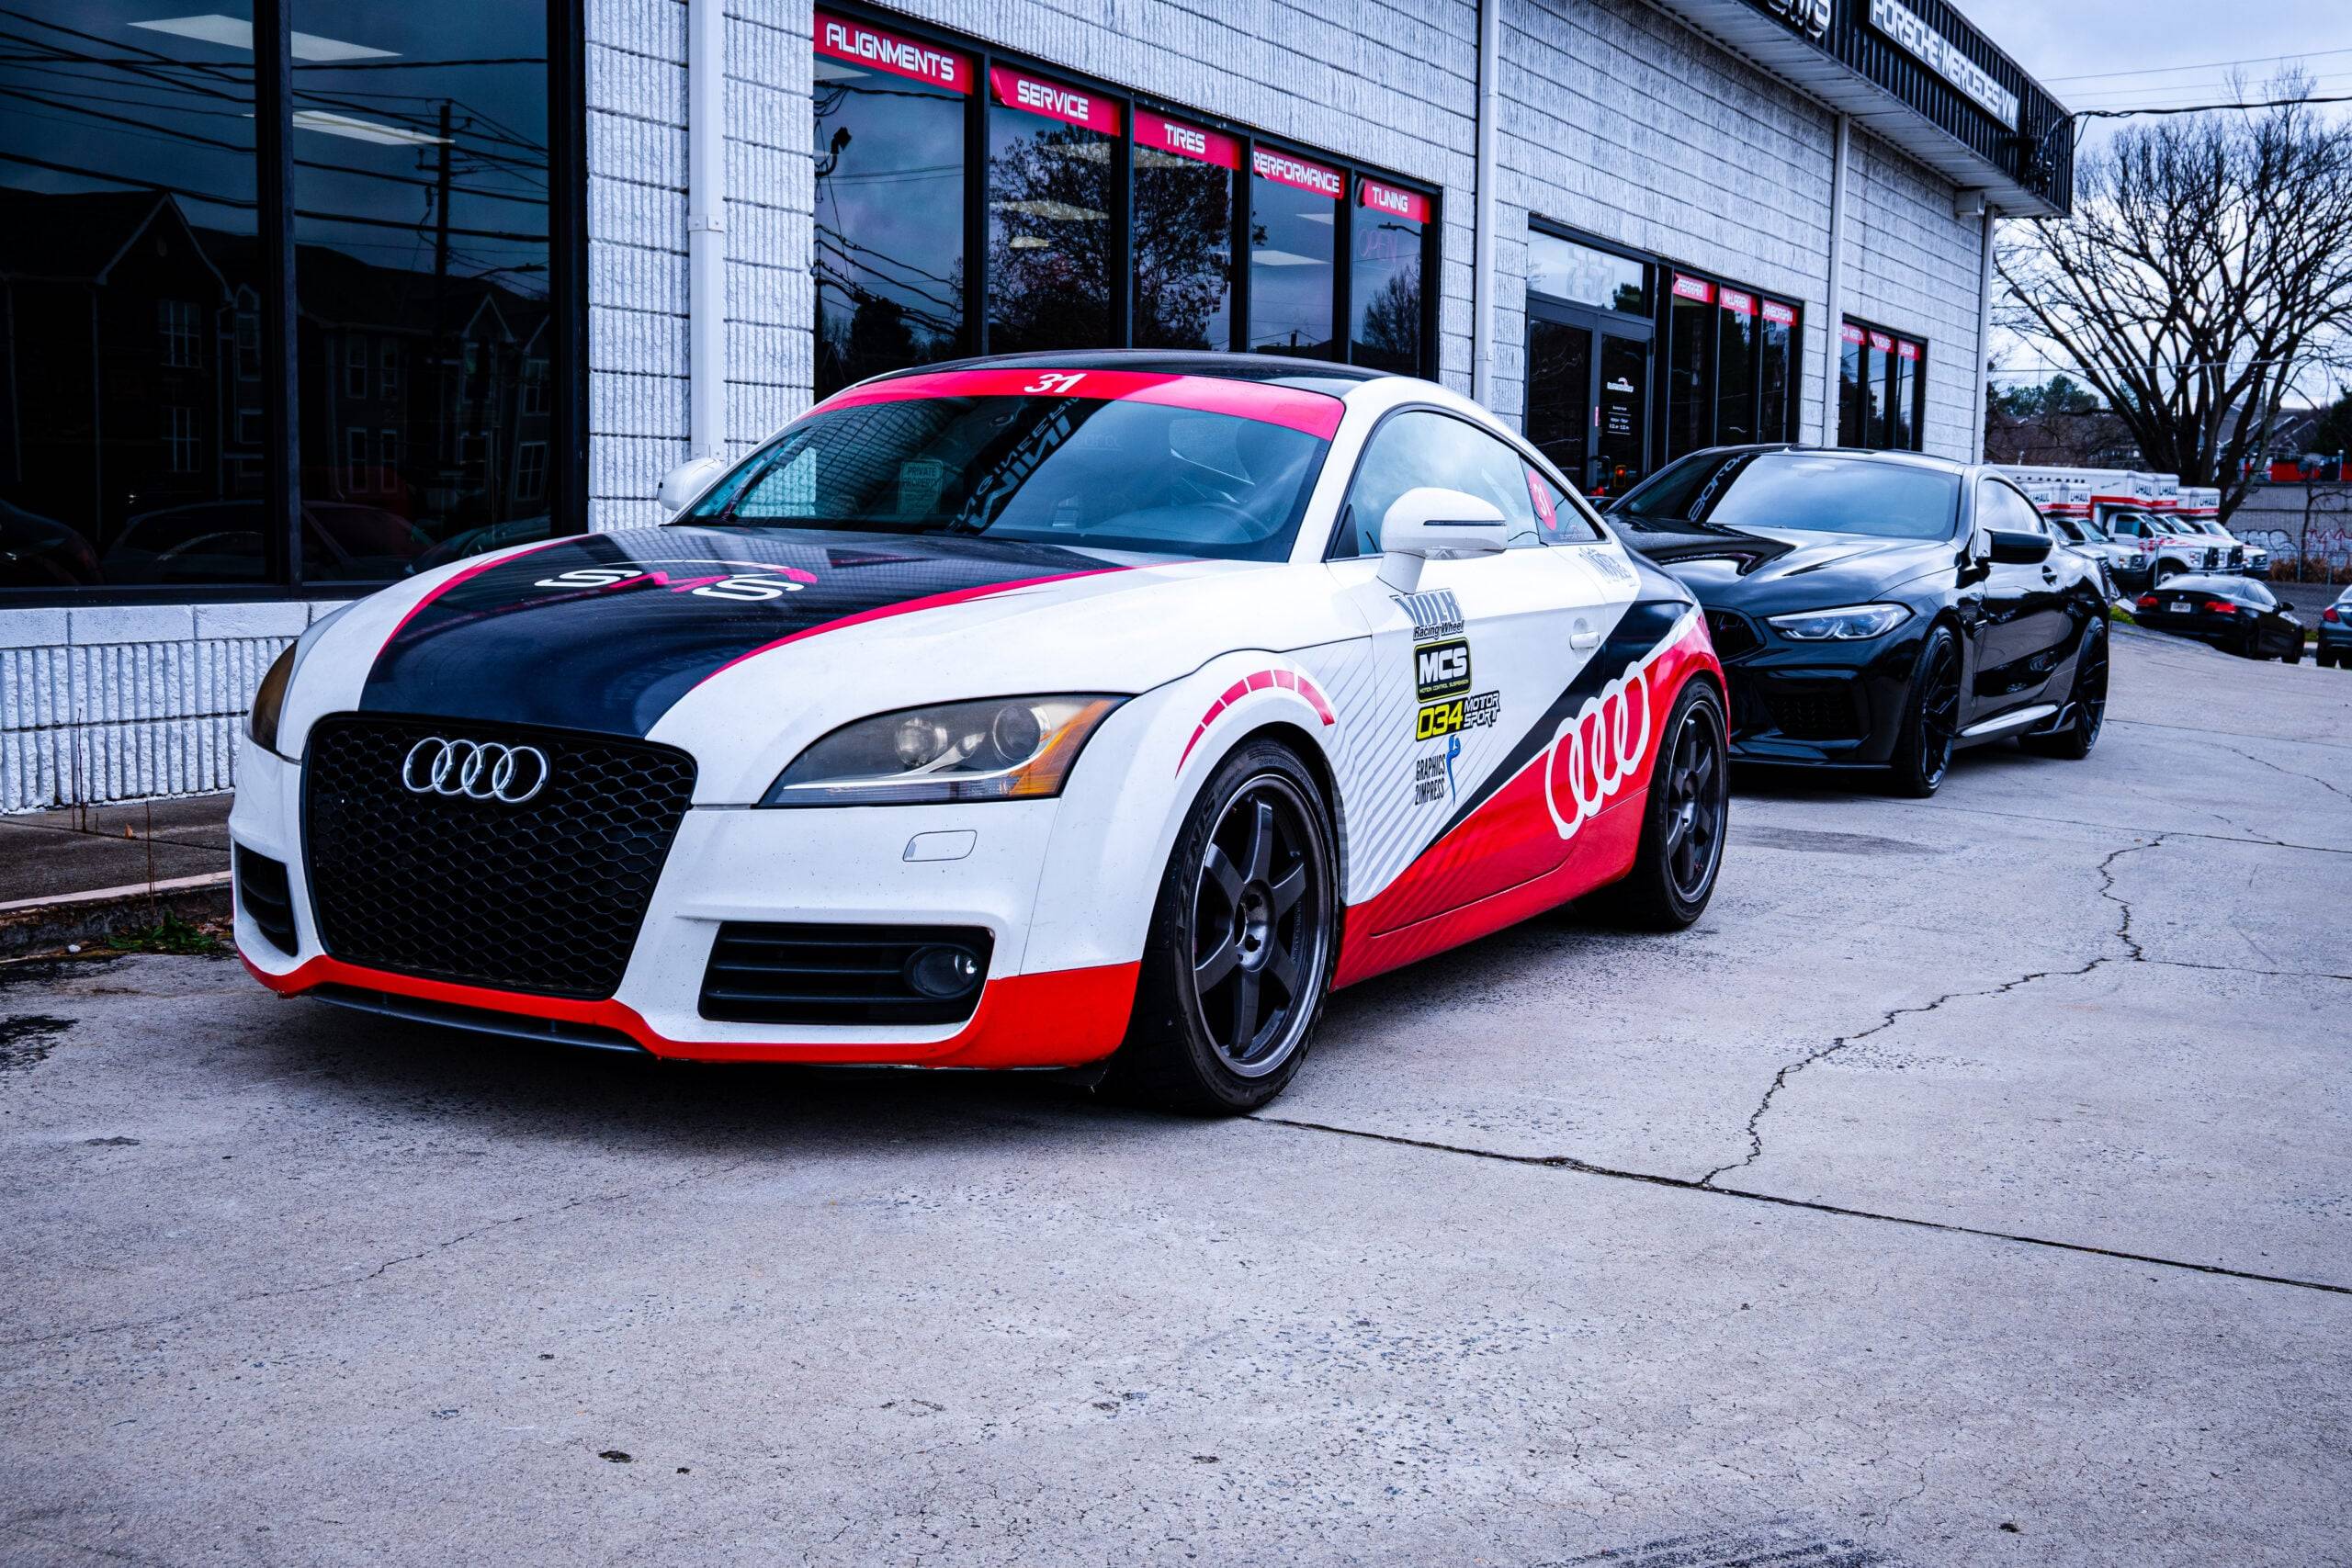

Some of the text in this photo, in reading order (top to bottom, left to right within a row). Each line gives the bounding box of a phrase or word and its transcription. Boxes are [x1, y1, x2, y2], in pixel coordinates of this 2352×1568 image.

[825, 21, 954, 82] ALIGNMENTS
[1017, 79, 1089, 121] SERVICE
[1164, 123, 1206, 153] TIRES
[1253, 151, 1340, 194] PERFORMANCE
[1372, 186, 1408, 212] TUNING
[1023, 373, 1088, 393] 31
[908, 466, 936, 477] PRIVATE
[1532, 483, 1552, 517] 31
[1419, 647, 1467, 685] MCS
[1464, 693, 1499, 715] MOTOR
[1464, 707, 1499, 728] SPORT
[1417, 700, 1463, 740] 034
[1416, 753, 1446, 781] GRAPHICS
